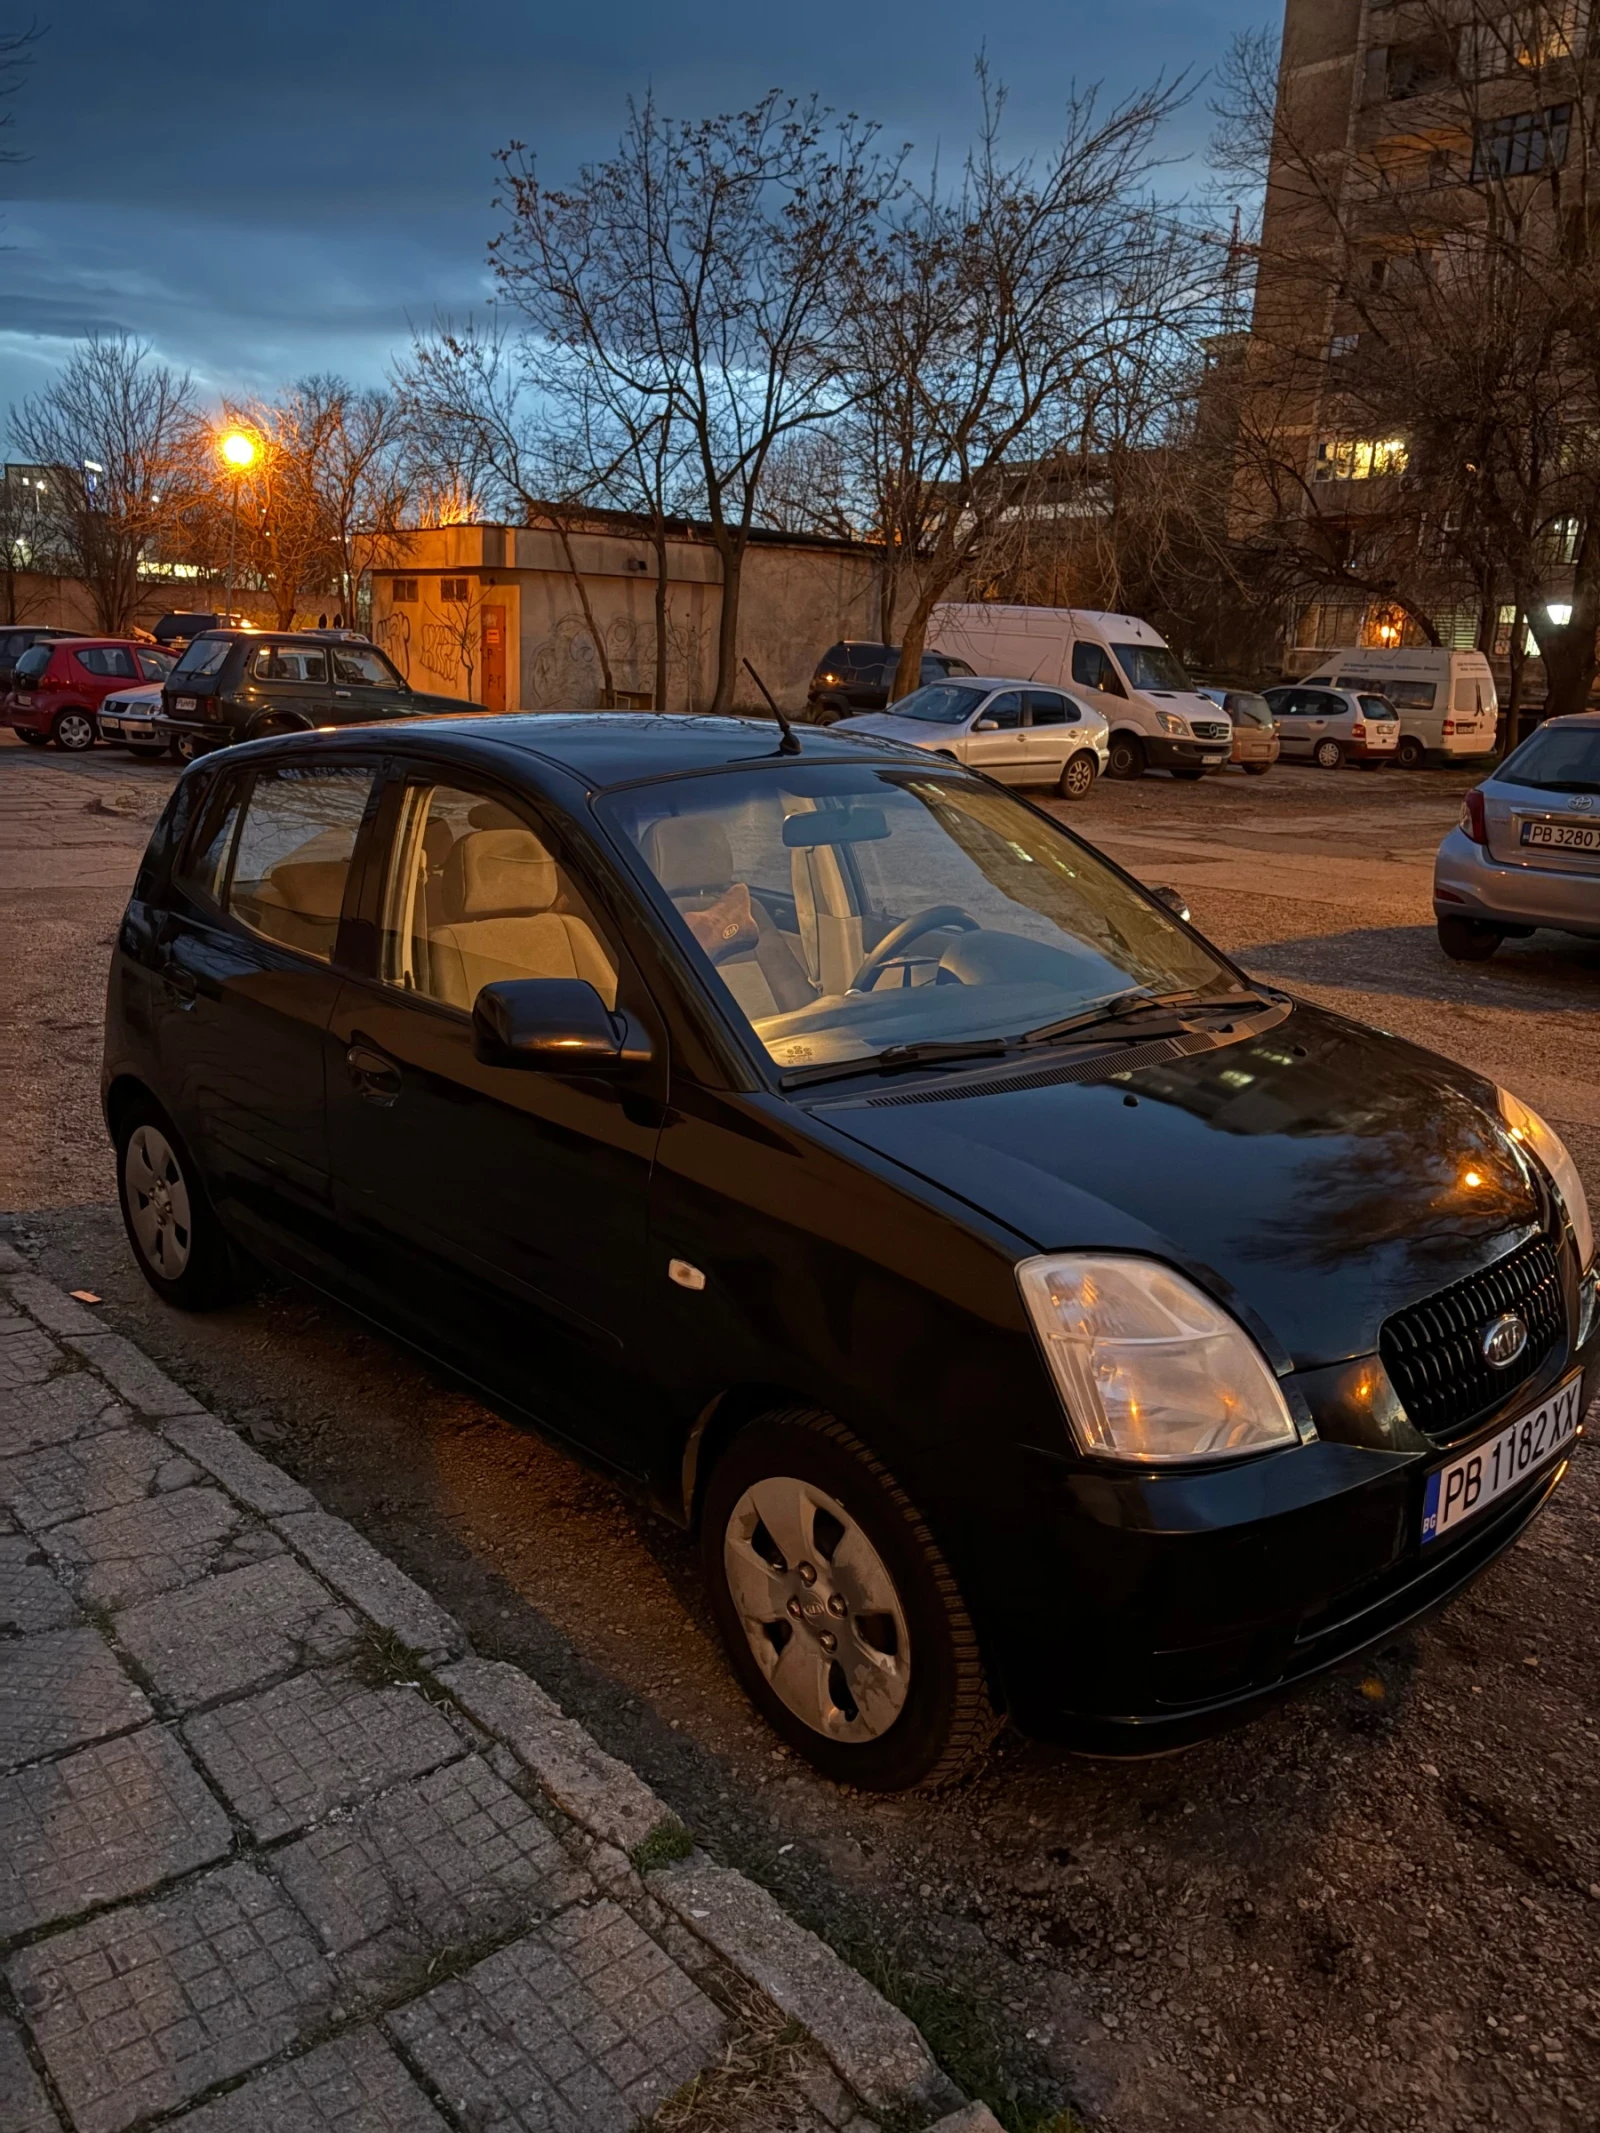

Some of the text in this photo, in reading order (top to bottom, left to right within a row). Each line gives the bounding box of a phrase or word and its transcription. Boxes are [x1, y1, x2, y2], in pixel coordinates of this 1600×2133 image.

[1532, 826, 1553, 842] PB
[1555, 829, 1593, 847] 3280
[1492, 1325, 1521, 1361] KIA
[1443, 1384, 1578, 1524] PB 1182 XX
[1422, 1514, 1437, 1534] BG
